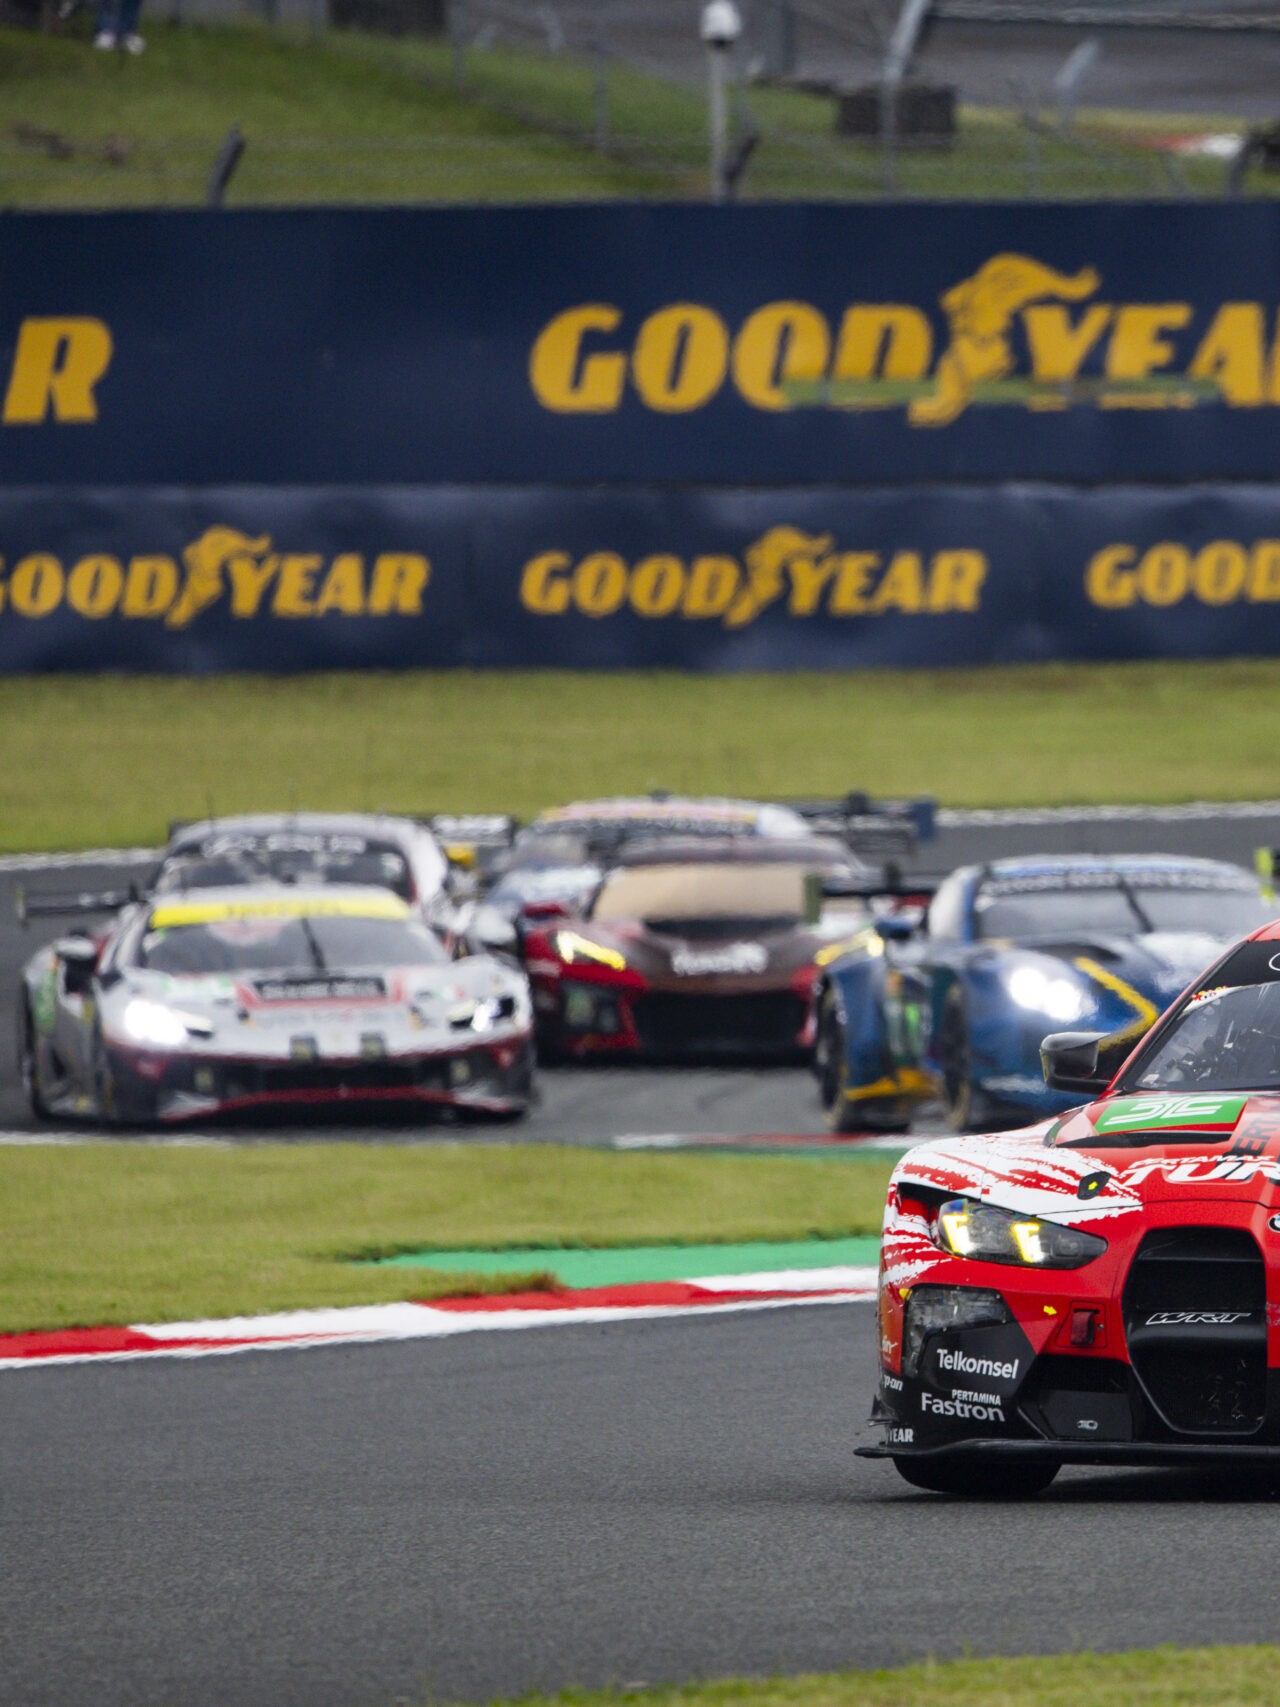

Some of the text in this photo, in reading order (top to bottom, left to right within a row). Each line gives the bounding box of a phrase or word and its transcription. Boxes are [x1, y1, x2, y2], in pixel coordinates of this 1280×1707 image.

[0, 552, 430, 620] OODYEAR
[520, 550, 988, 618] GOODYEAR
[1145, 1312, 1252, 1325] WRT
[936, 1348, 1020, 1380] Telkomsel
[920, 1391, 1006, 1423] Fastron
[951, 1388, 1002, 1406] PERTAMINA
